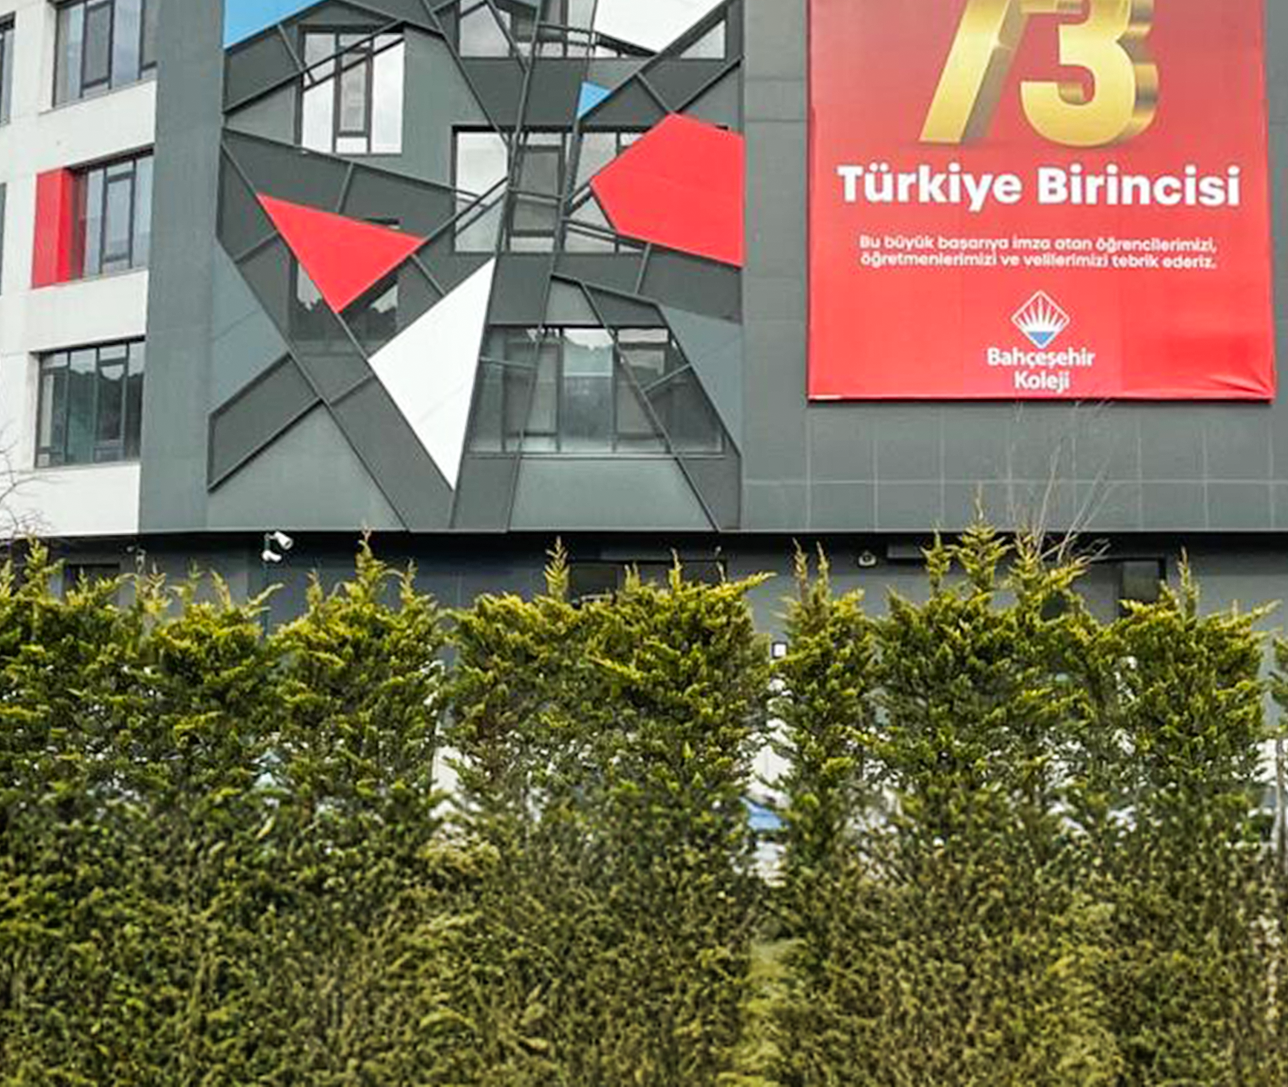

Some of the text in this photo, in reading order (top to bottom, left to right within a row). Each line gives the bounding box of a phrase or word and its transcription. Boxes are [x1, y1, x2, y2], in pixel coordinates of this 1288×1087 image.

[837, 162, 1240, 212] Türkiye Birincisi
[859, 235, 880, 249] Bu
[884, 235, 934, 251] büyük
[937, 235, 1009, 251] başarıya
[1054, 238, 1092, 251] atan
[860, 251, 997, 268] öğretmenlerimizi
[1001, 254, 1020, 266] ve
[1023, 254, 1109, 267] velilerimizi
[1111, 254, 1160, 268] tebrik
[987, 347, 1095, 391] Bahçeşehir Koleji
